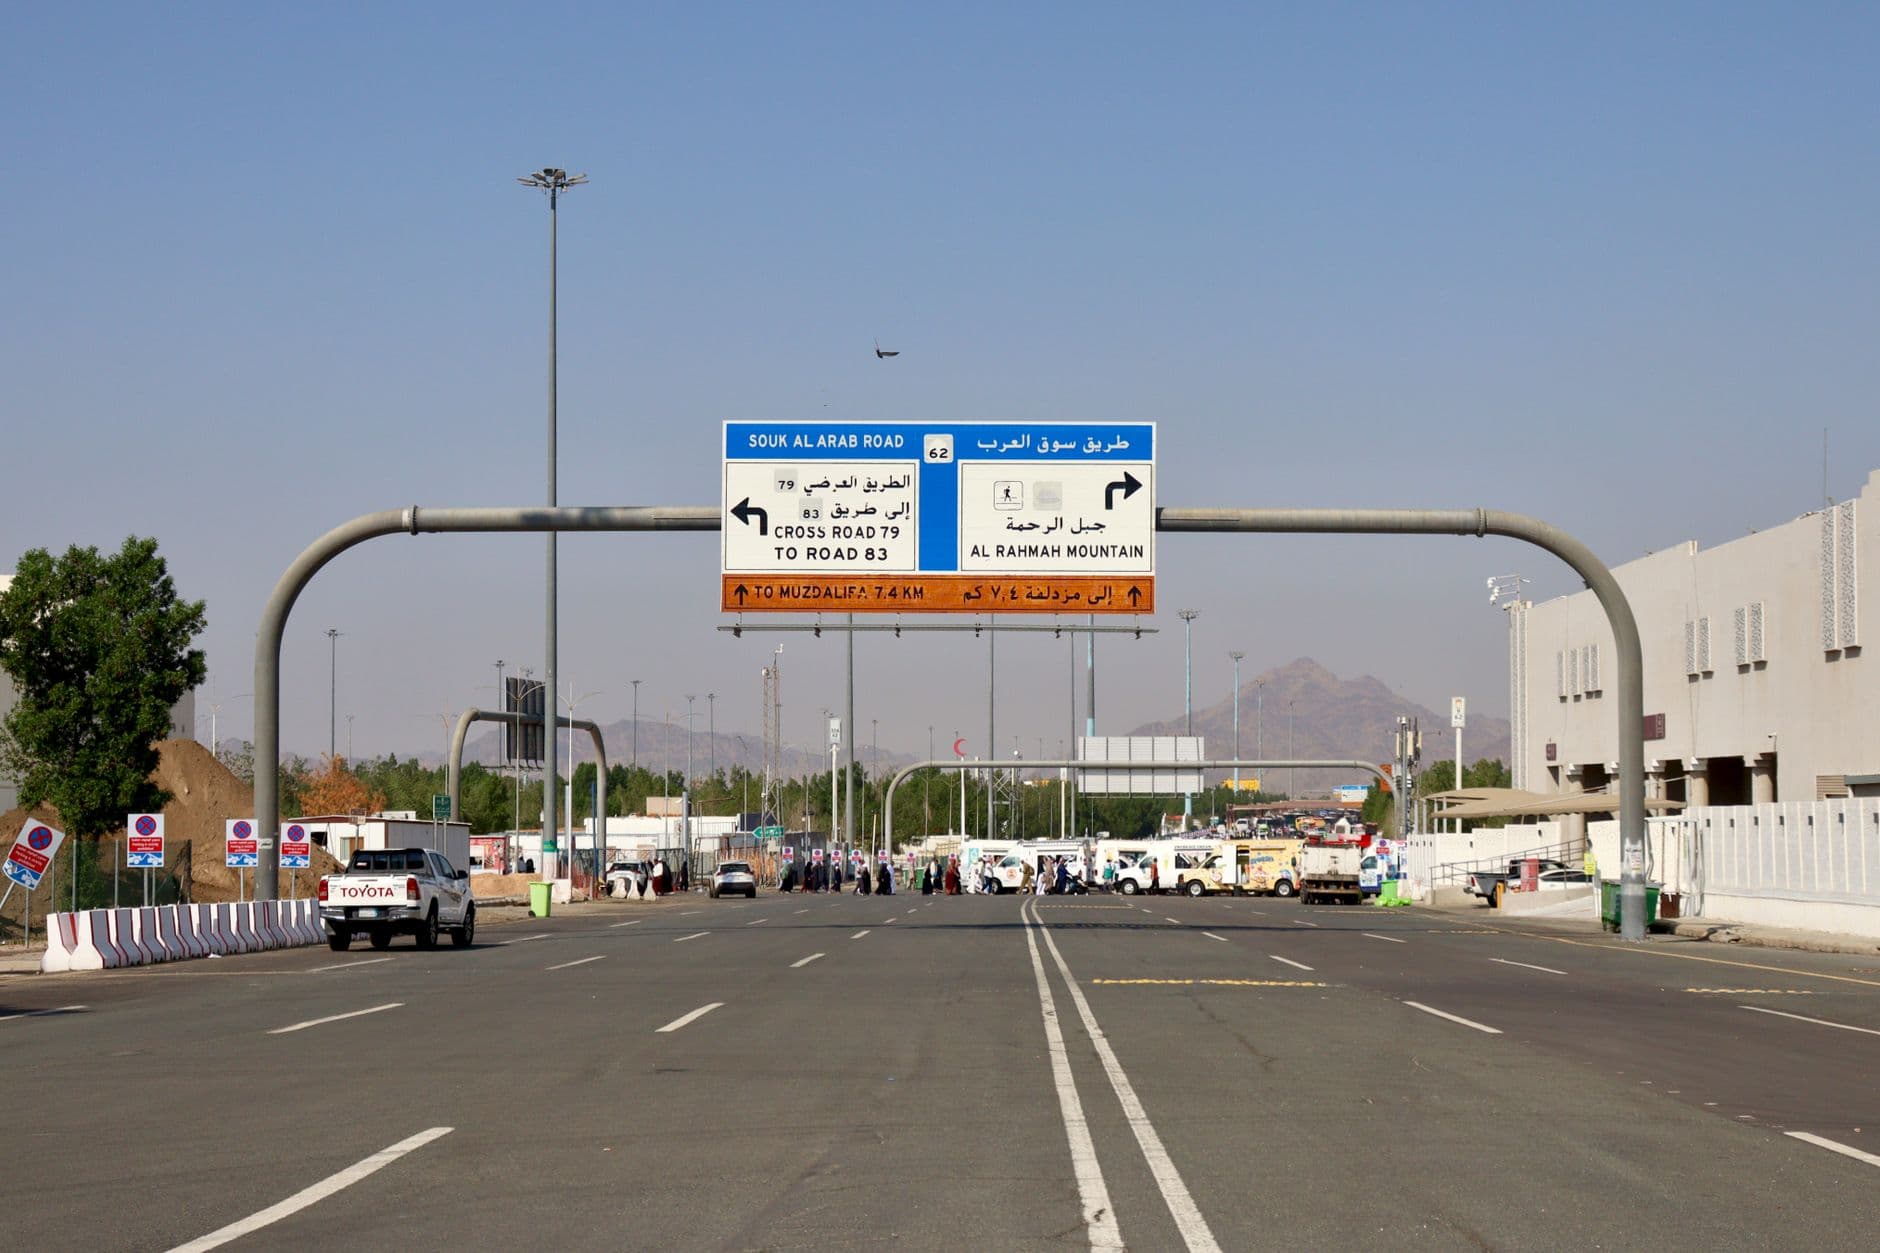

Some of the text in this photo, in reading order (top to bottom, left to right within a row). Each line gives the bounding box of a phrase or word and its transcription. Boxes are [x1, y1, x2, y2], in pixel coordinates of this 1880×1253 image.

[749, 434, 904, 448] SOUK AL ARAB ROAD
[977, 433, 1130, 453] طريق سوق العرب
[929, 448, 948, 459] 62
[778, 480, 795, 490] 79
[863, 474, 910, 493] الطريق
[802, 501, 910, 520] إلى طريق 83
[774, 525, 900, 539] CROSS ROAD 79
[1006, 516, 1106, 535] جبل الرحمة
[774, 547, 888, 561] TO ROAD 83
[970, 544, 1143, 558] AL RAHMAH MOUNTAIN
[755, 586, 924, 599] TO MUZDALIFA 7.4 KM
[963, 585, 983, 605] كم
[1025, 585, 1081, 604] مزدلفة
[1087, 585, 1112, 605] إلى
[340, 888, 394, 897] TOYOTA
